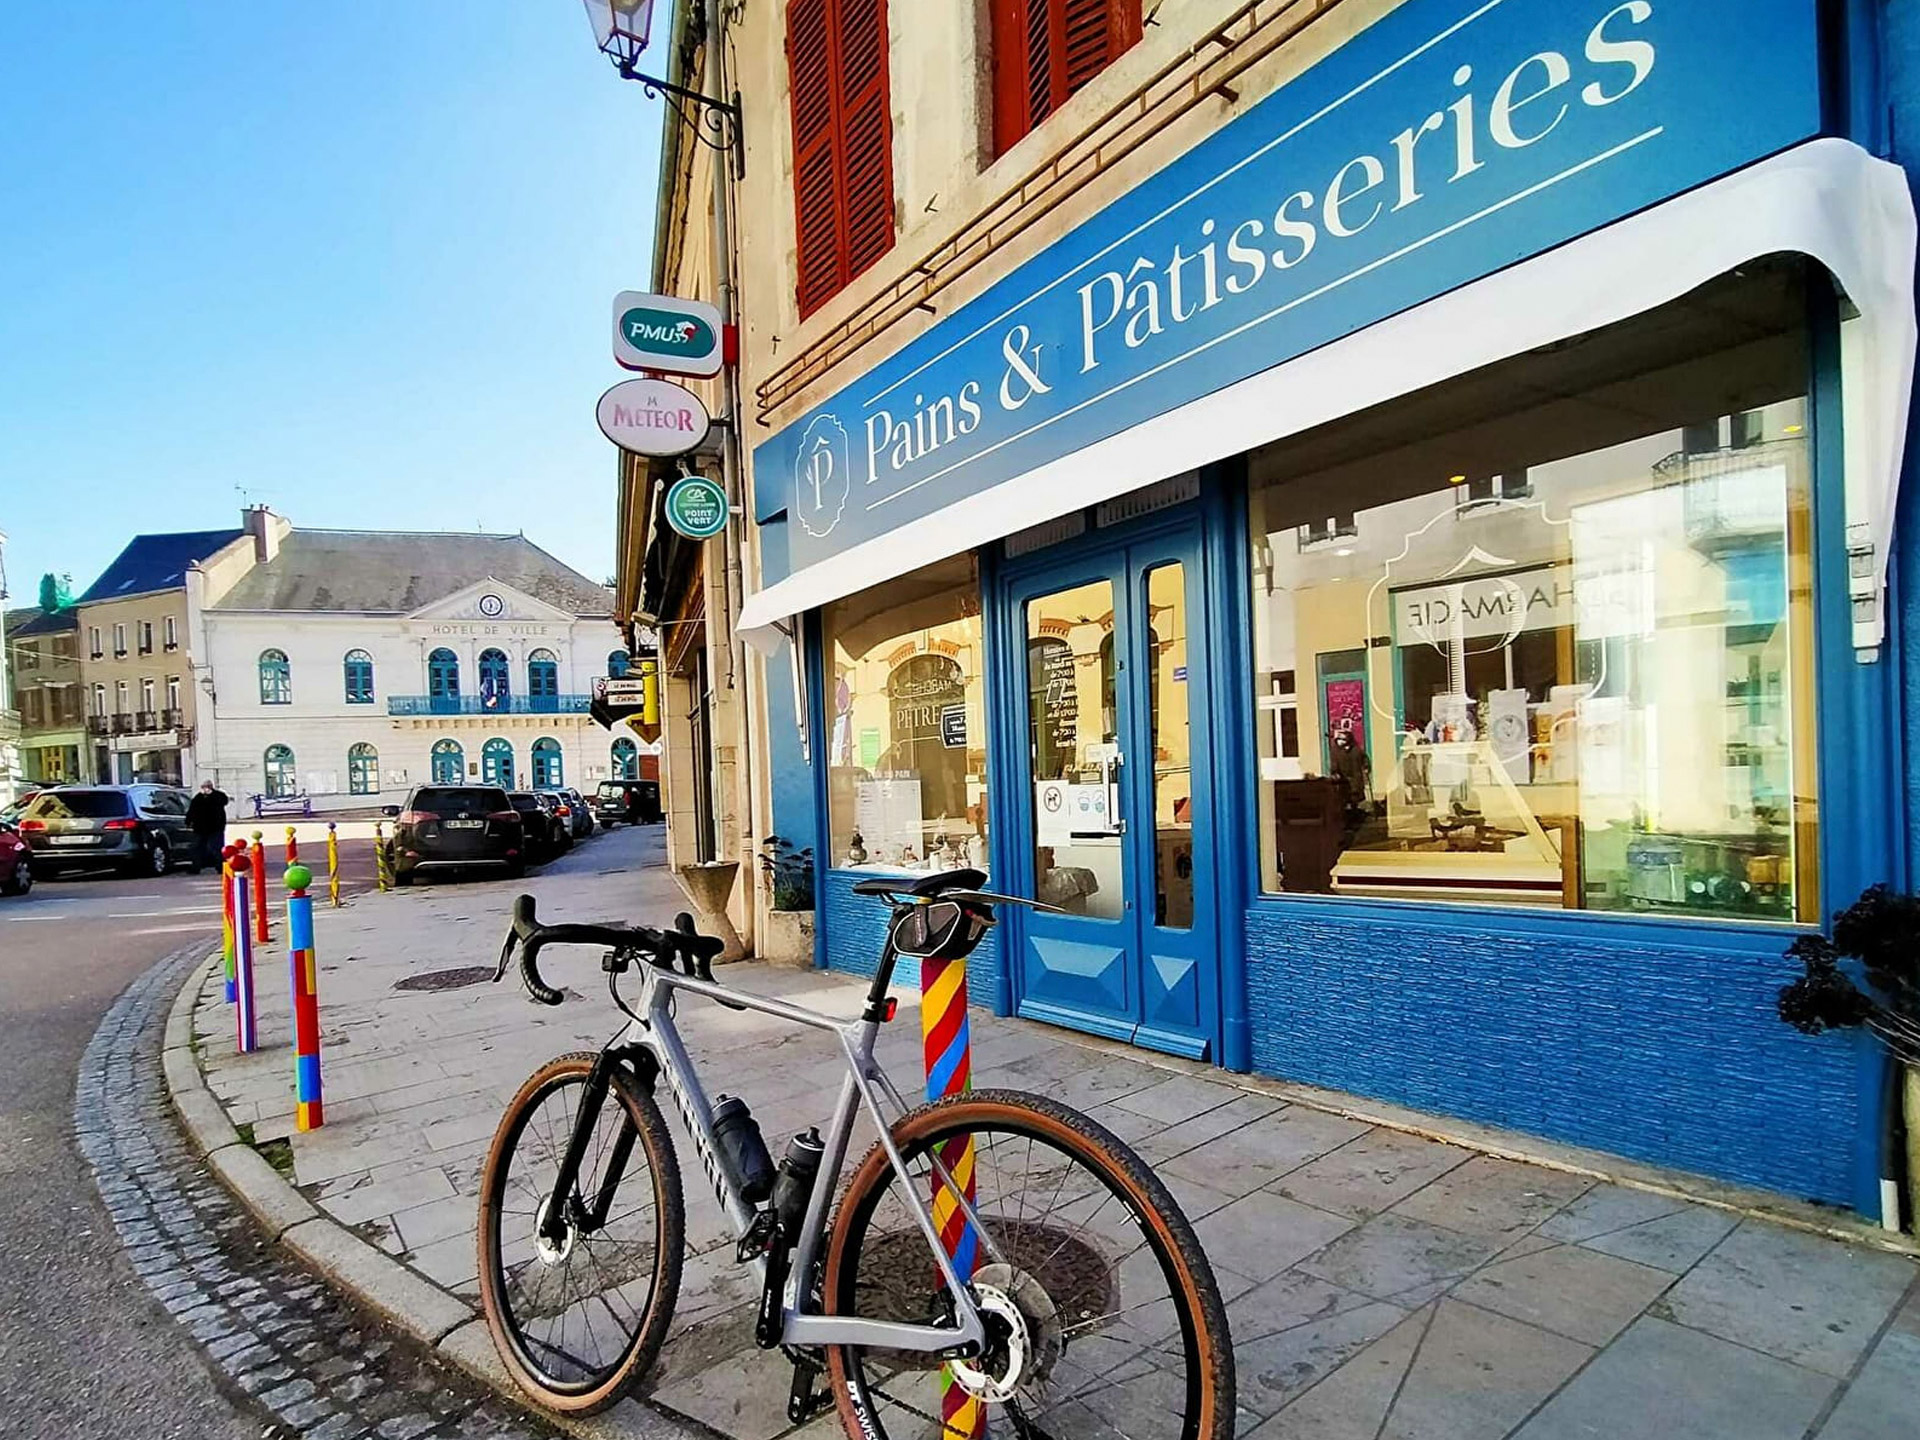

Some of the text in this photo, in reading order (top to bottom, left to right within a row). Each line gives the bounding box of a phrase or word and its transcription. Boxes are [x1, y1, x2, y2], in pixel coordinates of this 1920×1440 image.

[863, 0, 1656, 484] Pains & Pâtisseries
[630, 321, 674, 342] PMU
[612, 403, 694, 432] METEOR
[484, 626, 499, 635] DE
[511, 626, 548, 635] VILLE
[855, 1407, 879, 1440] SWIS
